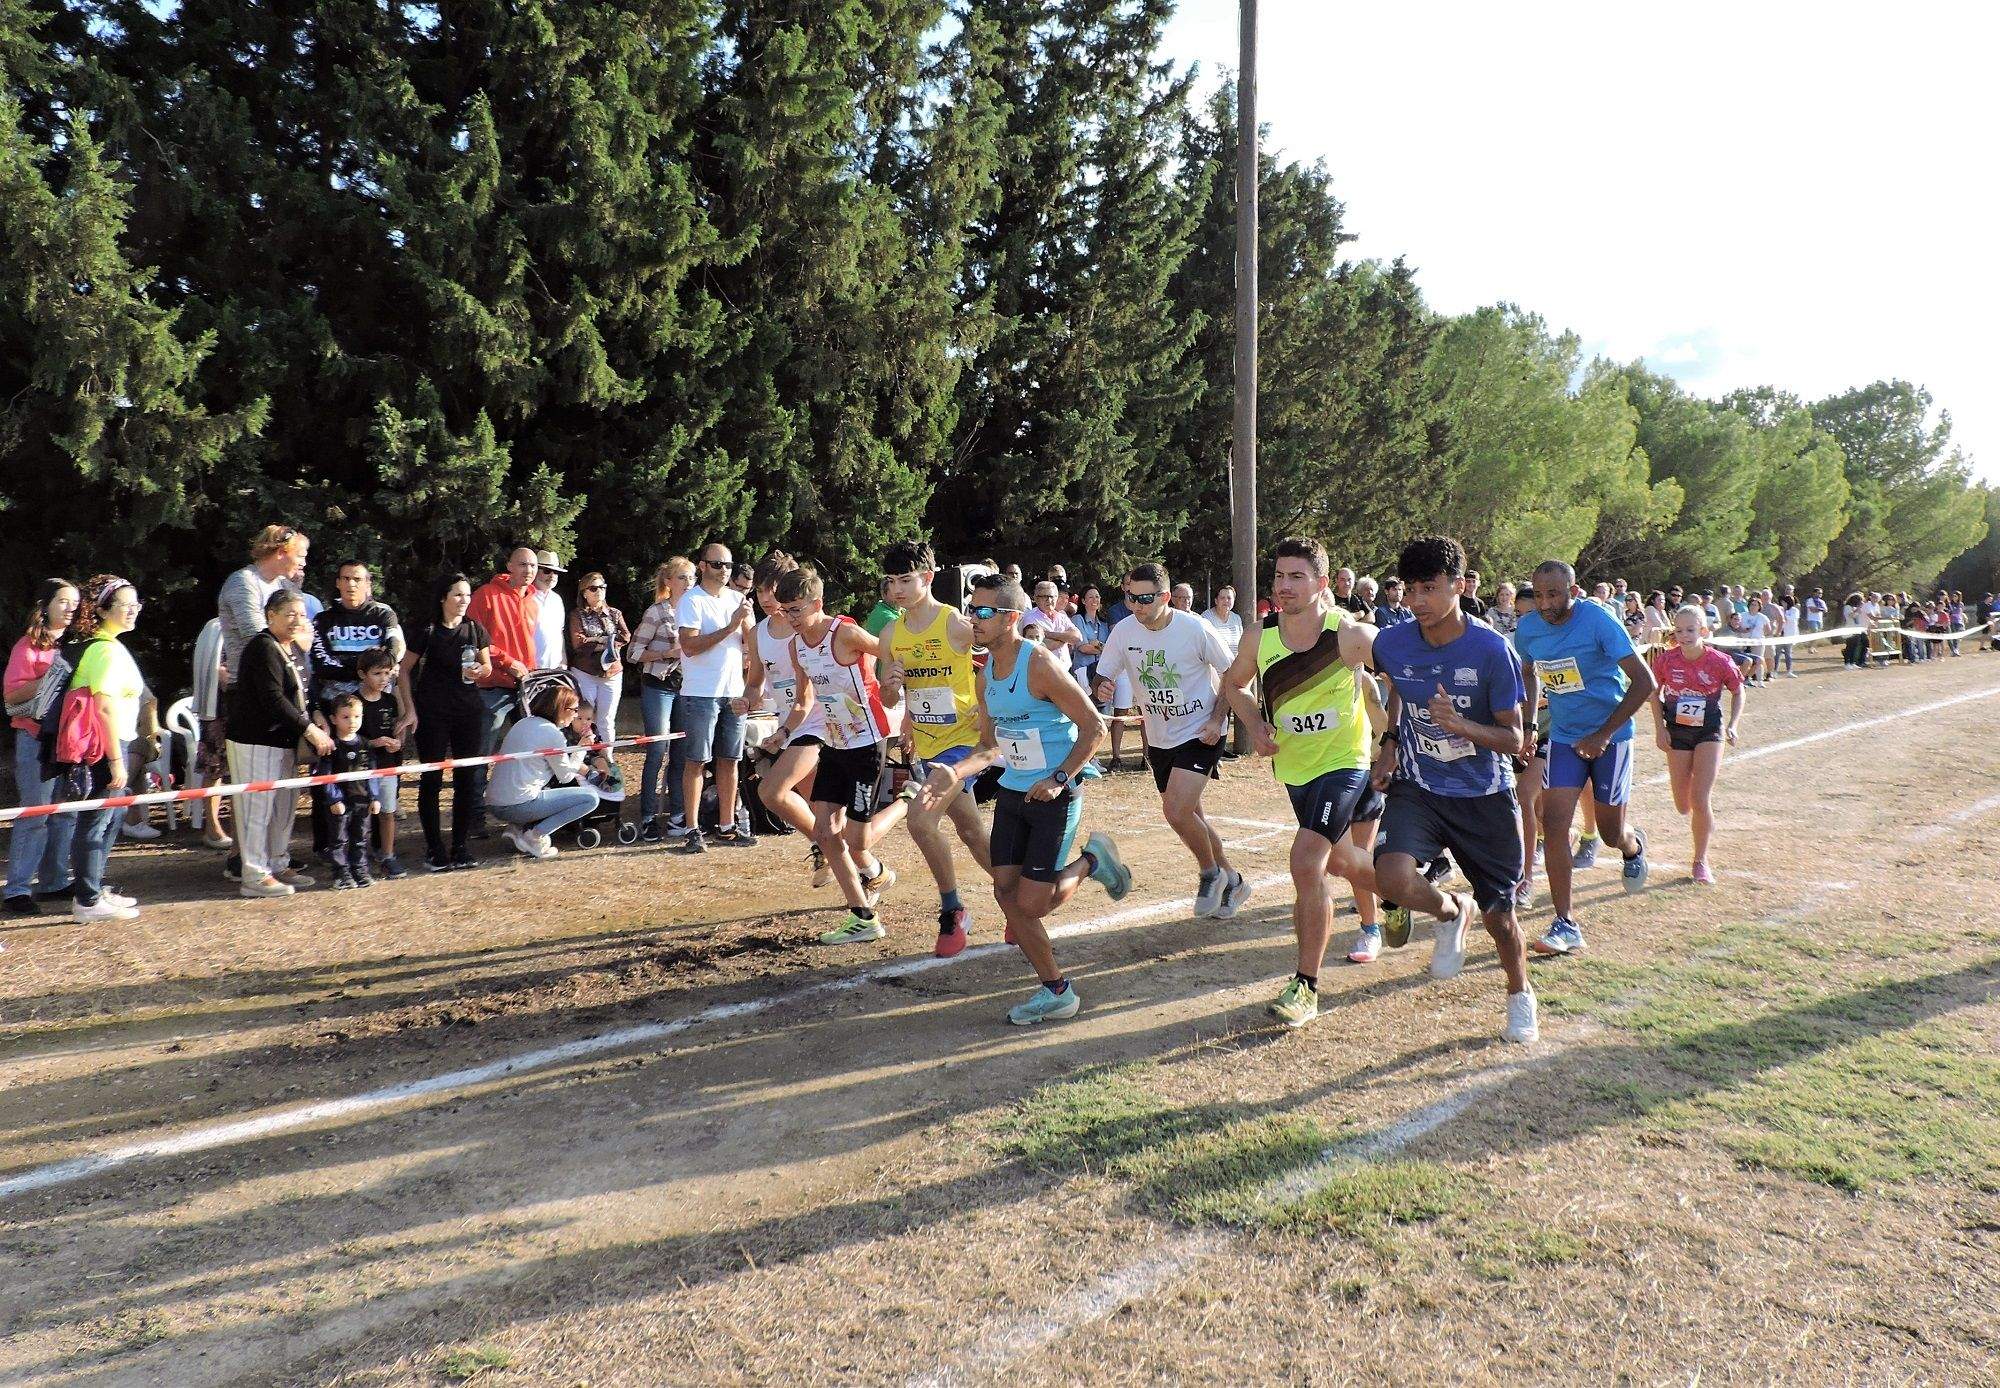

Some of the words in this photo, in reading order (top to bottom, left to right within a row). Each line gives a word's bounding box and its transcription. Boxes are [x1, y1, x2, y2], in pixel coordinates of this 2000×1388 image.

[327, 625, 382, 640] HUESC
[1146, 650, 1165, 667] 14
[785, 688, 794, 698] 6
[1148, 690, 1175, 704] 345
[824, 704, 832, 713] 5
[922, 701, 931, 713] 9
[1681, 704, 1701, 716] 27
[1291, 713, 1327, 733] 342
[1011, 741, 1019, 754] 1
